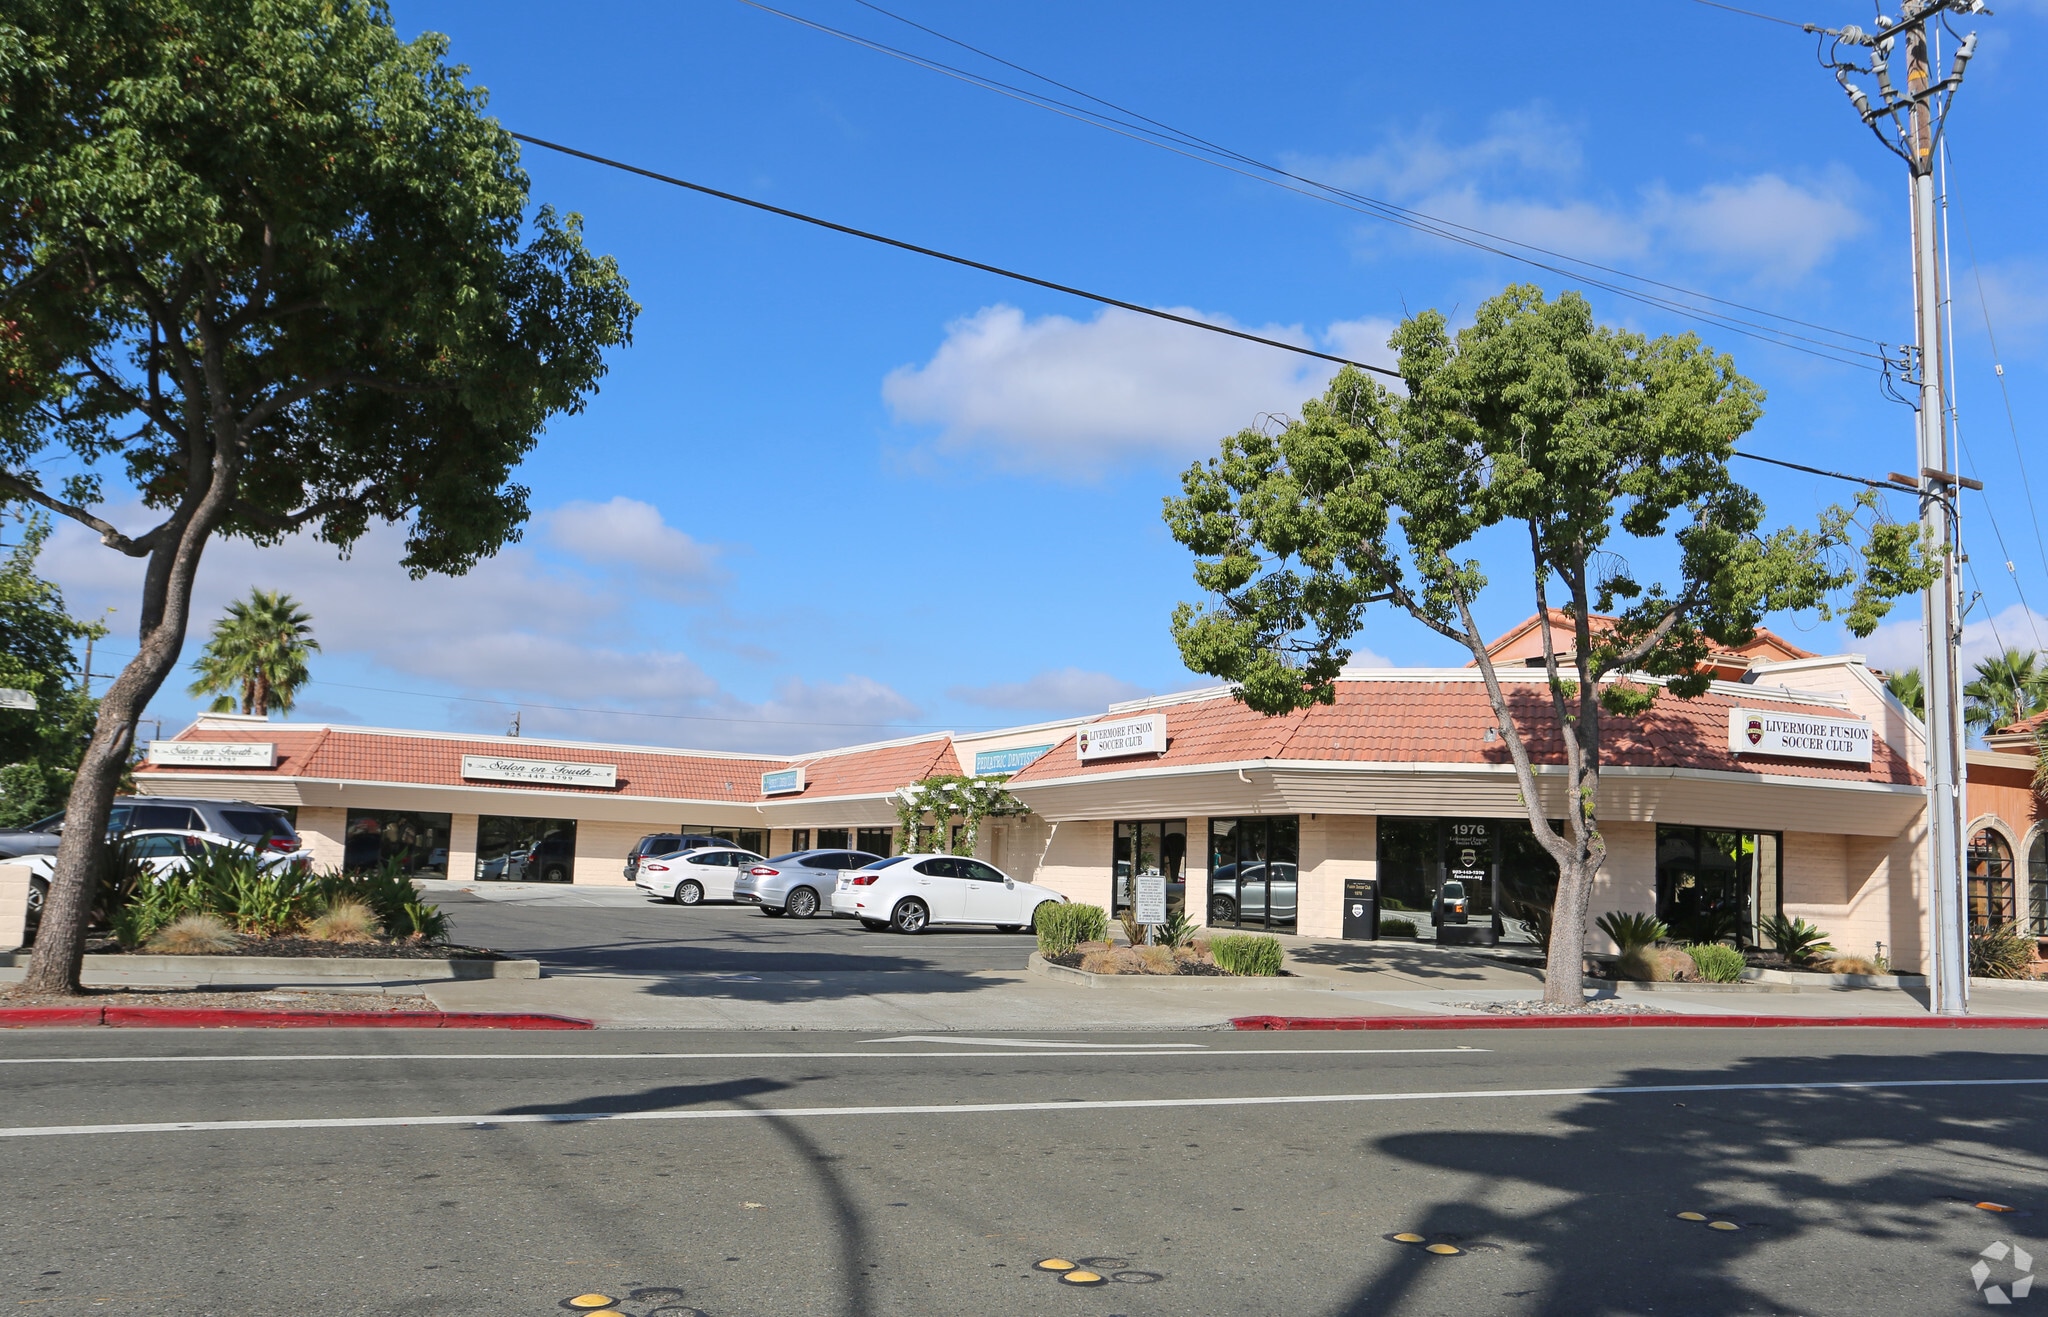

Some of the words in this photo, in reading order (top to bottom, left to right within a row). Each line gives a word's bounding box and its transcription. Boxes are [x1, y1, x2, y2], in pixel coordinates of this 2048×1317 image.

[1089, 726, 1126, 741] LIVERMORE
[1127, 721, 1153, 735] FUSION
[1766, 720, 1827, 737] LIVERMORE
[1830, 726, 1869, 740] FUSION
[170, 745, 199, 755] Salon
[1099, 739, 1124, 751] SOCCER
[1125, 736, 1143, 747] CLUB
[1781, 736, 1823, 750] SOCCER
[1826, 740, 1853, 752] CLUB
[489, 760, 525, 771] Salon
[976, 755, 1006, 770] PEDIATRIC
[504, 771, 573, 781] 925-449-4799
[1452, 824, 1485, 835] 1976
